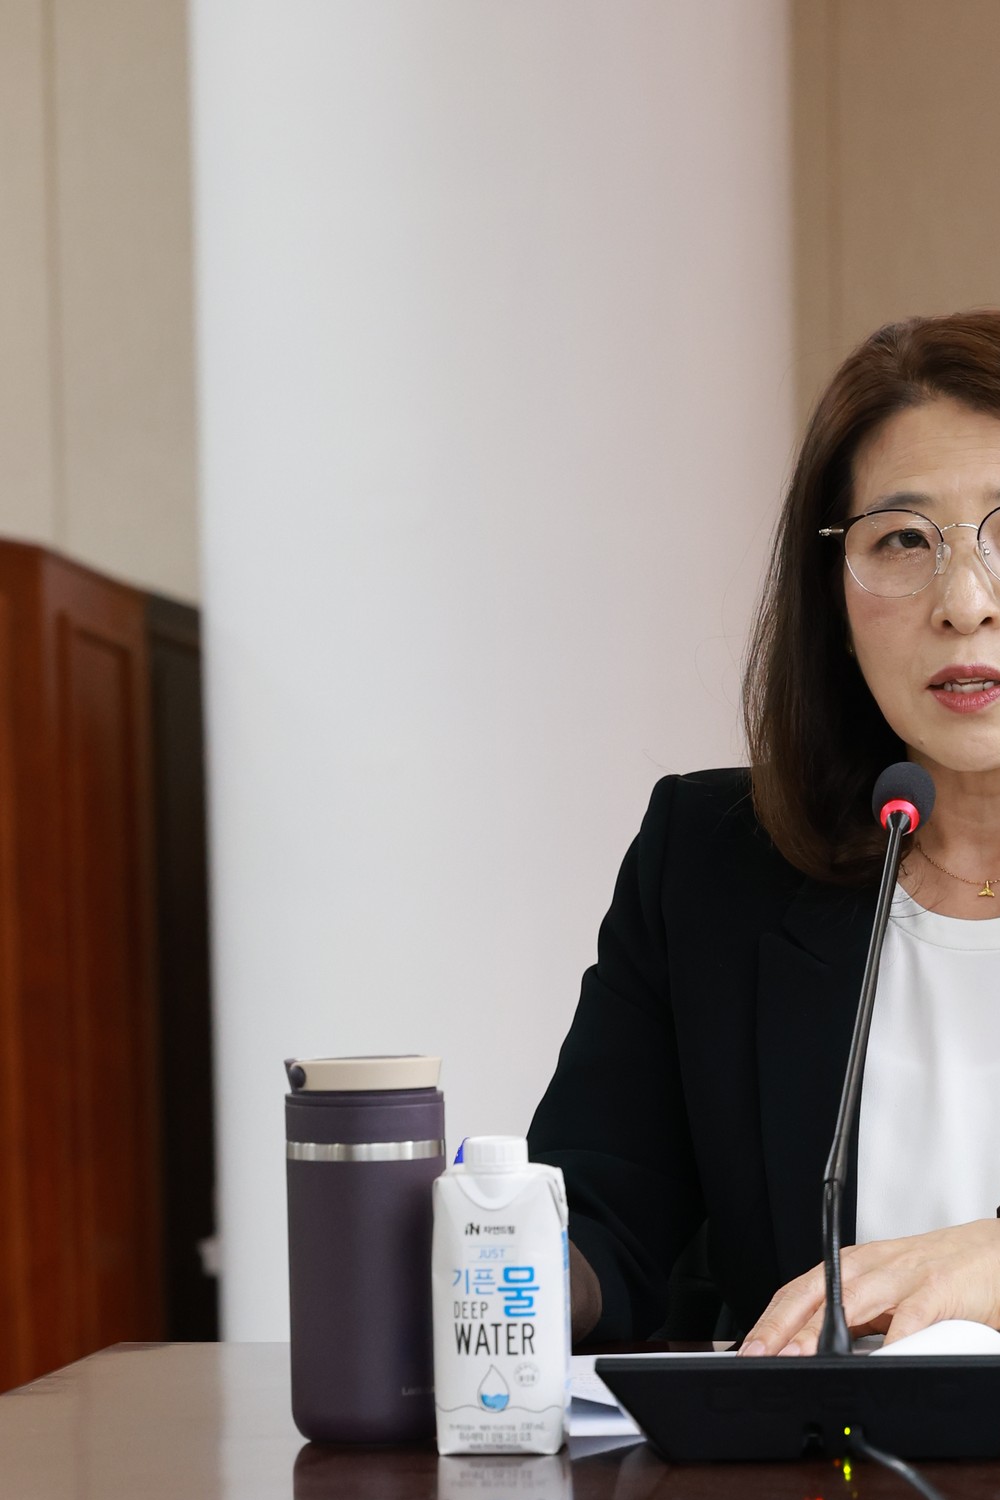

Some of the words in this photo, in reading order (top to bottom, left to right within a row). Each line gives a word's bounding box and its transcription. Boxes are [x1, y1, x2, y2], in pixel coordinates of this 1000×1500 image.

[479, 1248, 505, 1259] JUST
[454, 1301, 488, 1319] DEEP
[455, 1323, 535, 1355] WATER
